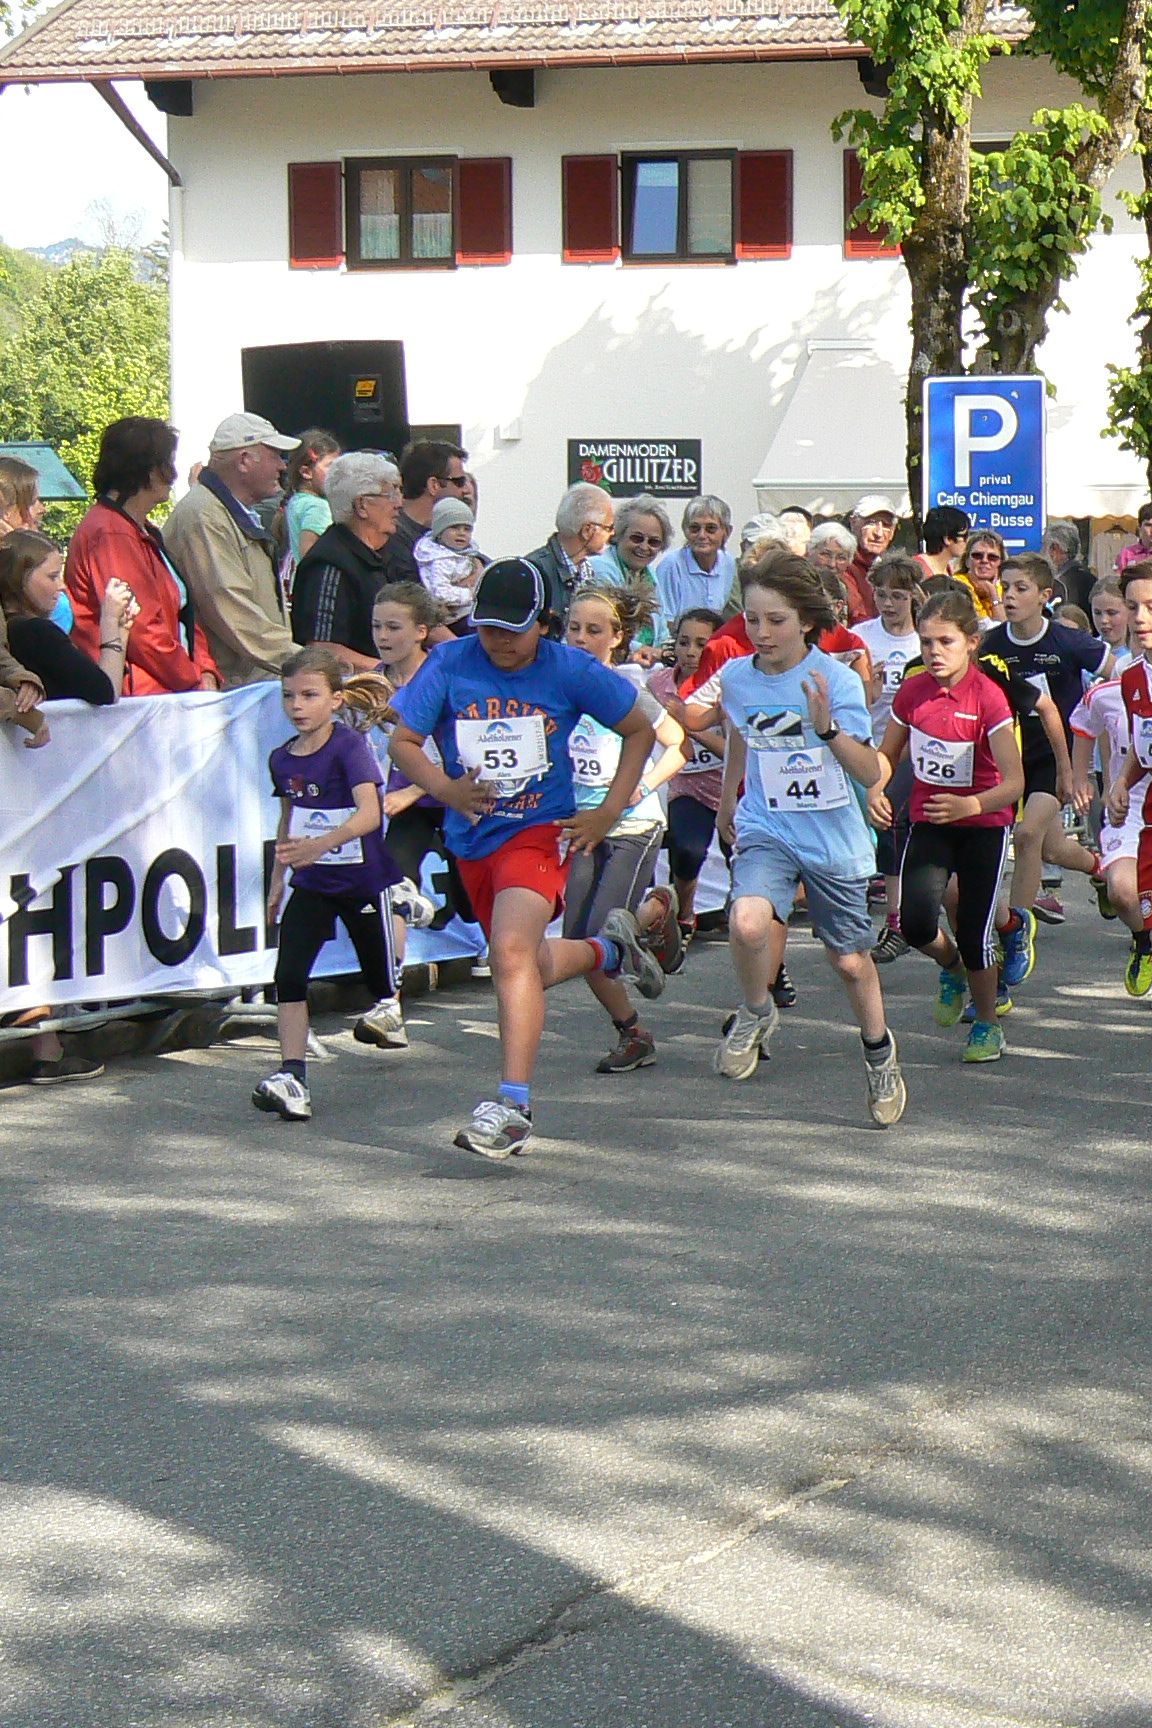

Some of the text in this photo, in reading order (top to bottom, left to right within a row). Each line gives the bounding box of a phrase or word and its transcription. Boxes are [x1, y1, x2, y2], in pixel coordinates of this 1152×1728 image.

[579, 444, 676, 456] DAMENMODEN
[955, 395, 1018, 487] P
[603, 458, 697, 482] GILLITZER
[979, 475, 1012, 486] privat
[937, 492, 1034, 508] Cafe Chiemgau
[991, 513, 1033, 527] Busse
[484, 749, 518, 769] 53
[574, 757, 601, 776] 29
[917, 757, 956, 778] 126
[786, 779, 821, 799] 44
